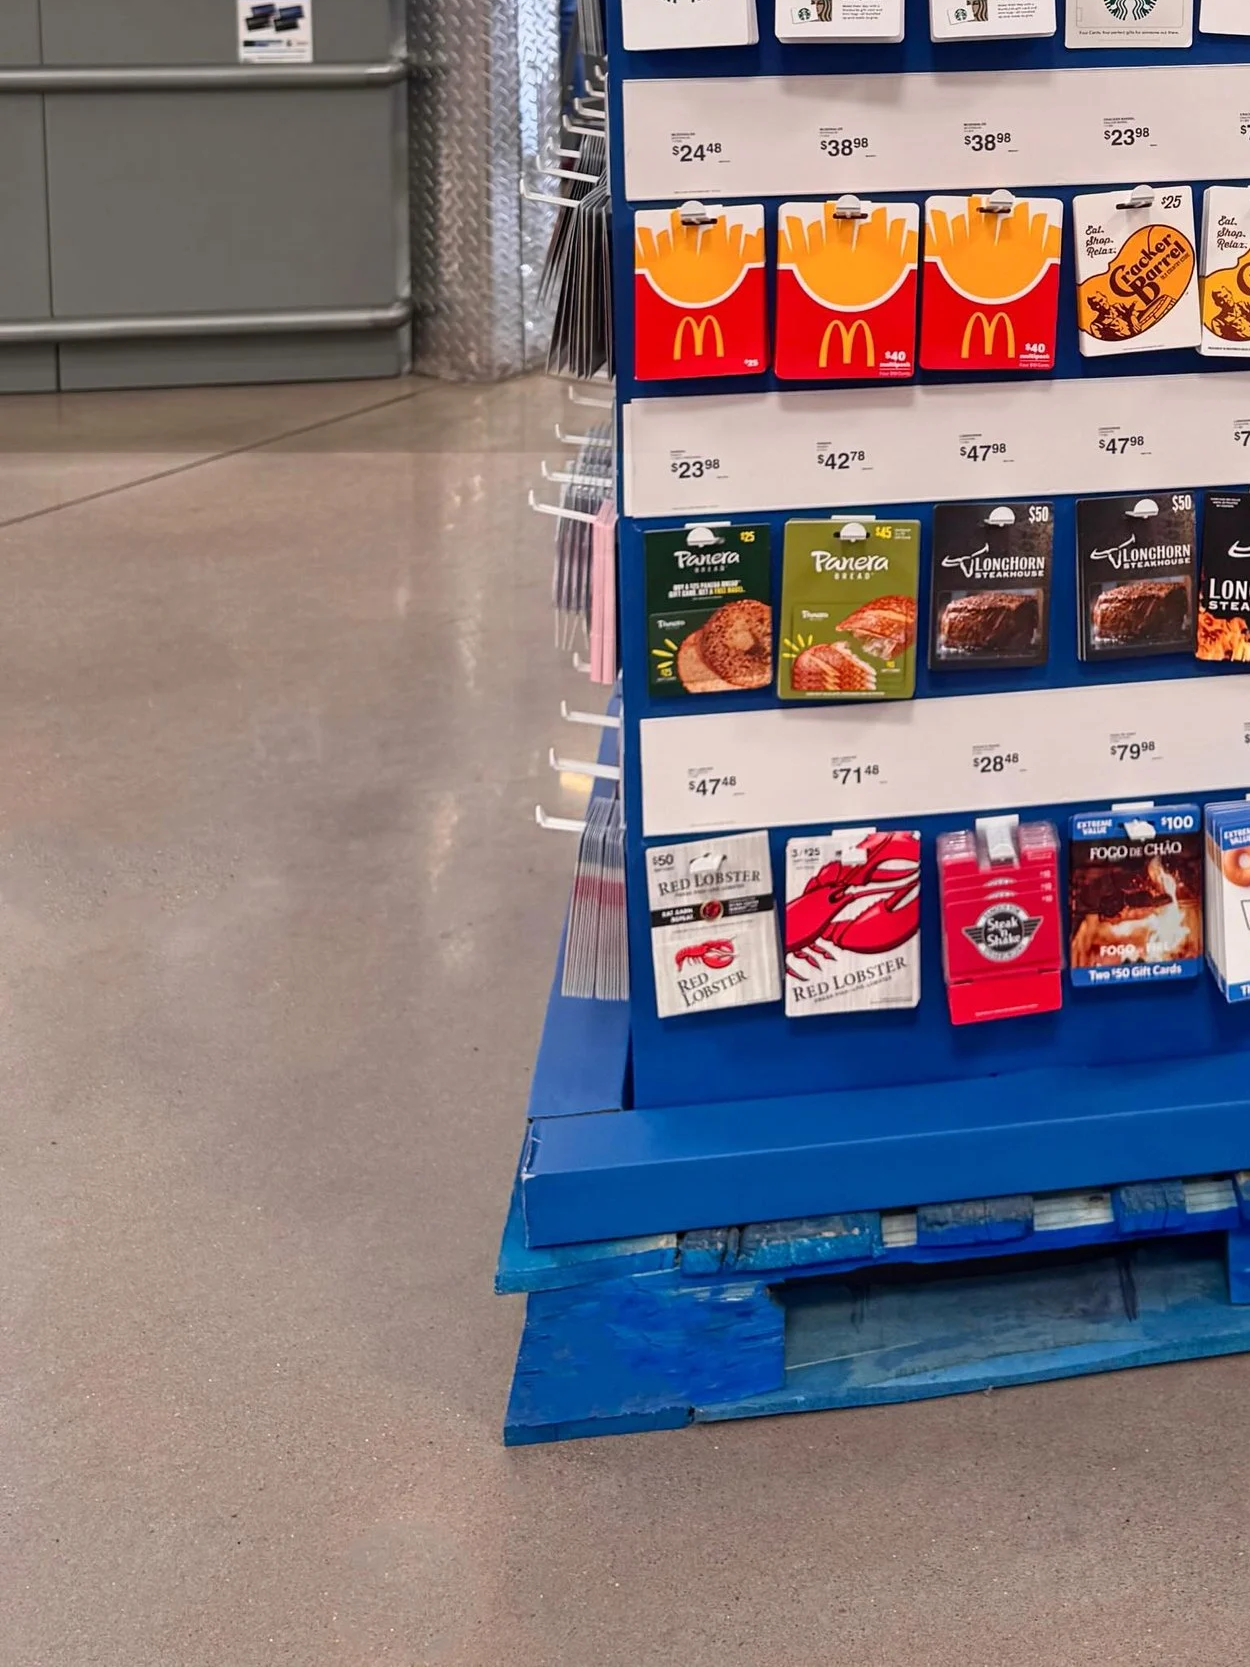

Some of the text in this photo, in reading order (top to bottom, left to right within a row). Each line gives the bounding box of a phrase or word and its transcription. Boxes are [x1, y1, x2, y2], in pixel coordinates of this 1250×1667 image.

[1161, 195, 1181, 211] $25
[1110, 233, 1173, 297] Cracker
[1128, 243, 1186, 307] Barrel
[875, 526, 892, 539] $45
[810, 550, 889, 573] Panera
[1160, 815, 1194, 830] $100
[1089, 845, 1127, 860] FOGO
[1129, 845, 1142, 856] DE
[792, 956, 908, 1003] RED LOBSTER
[1089, 963, 1182, 980] Two $50 Gift Cards
